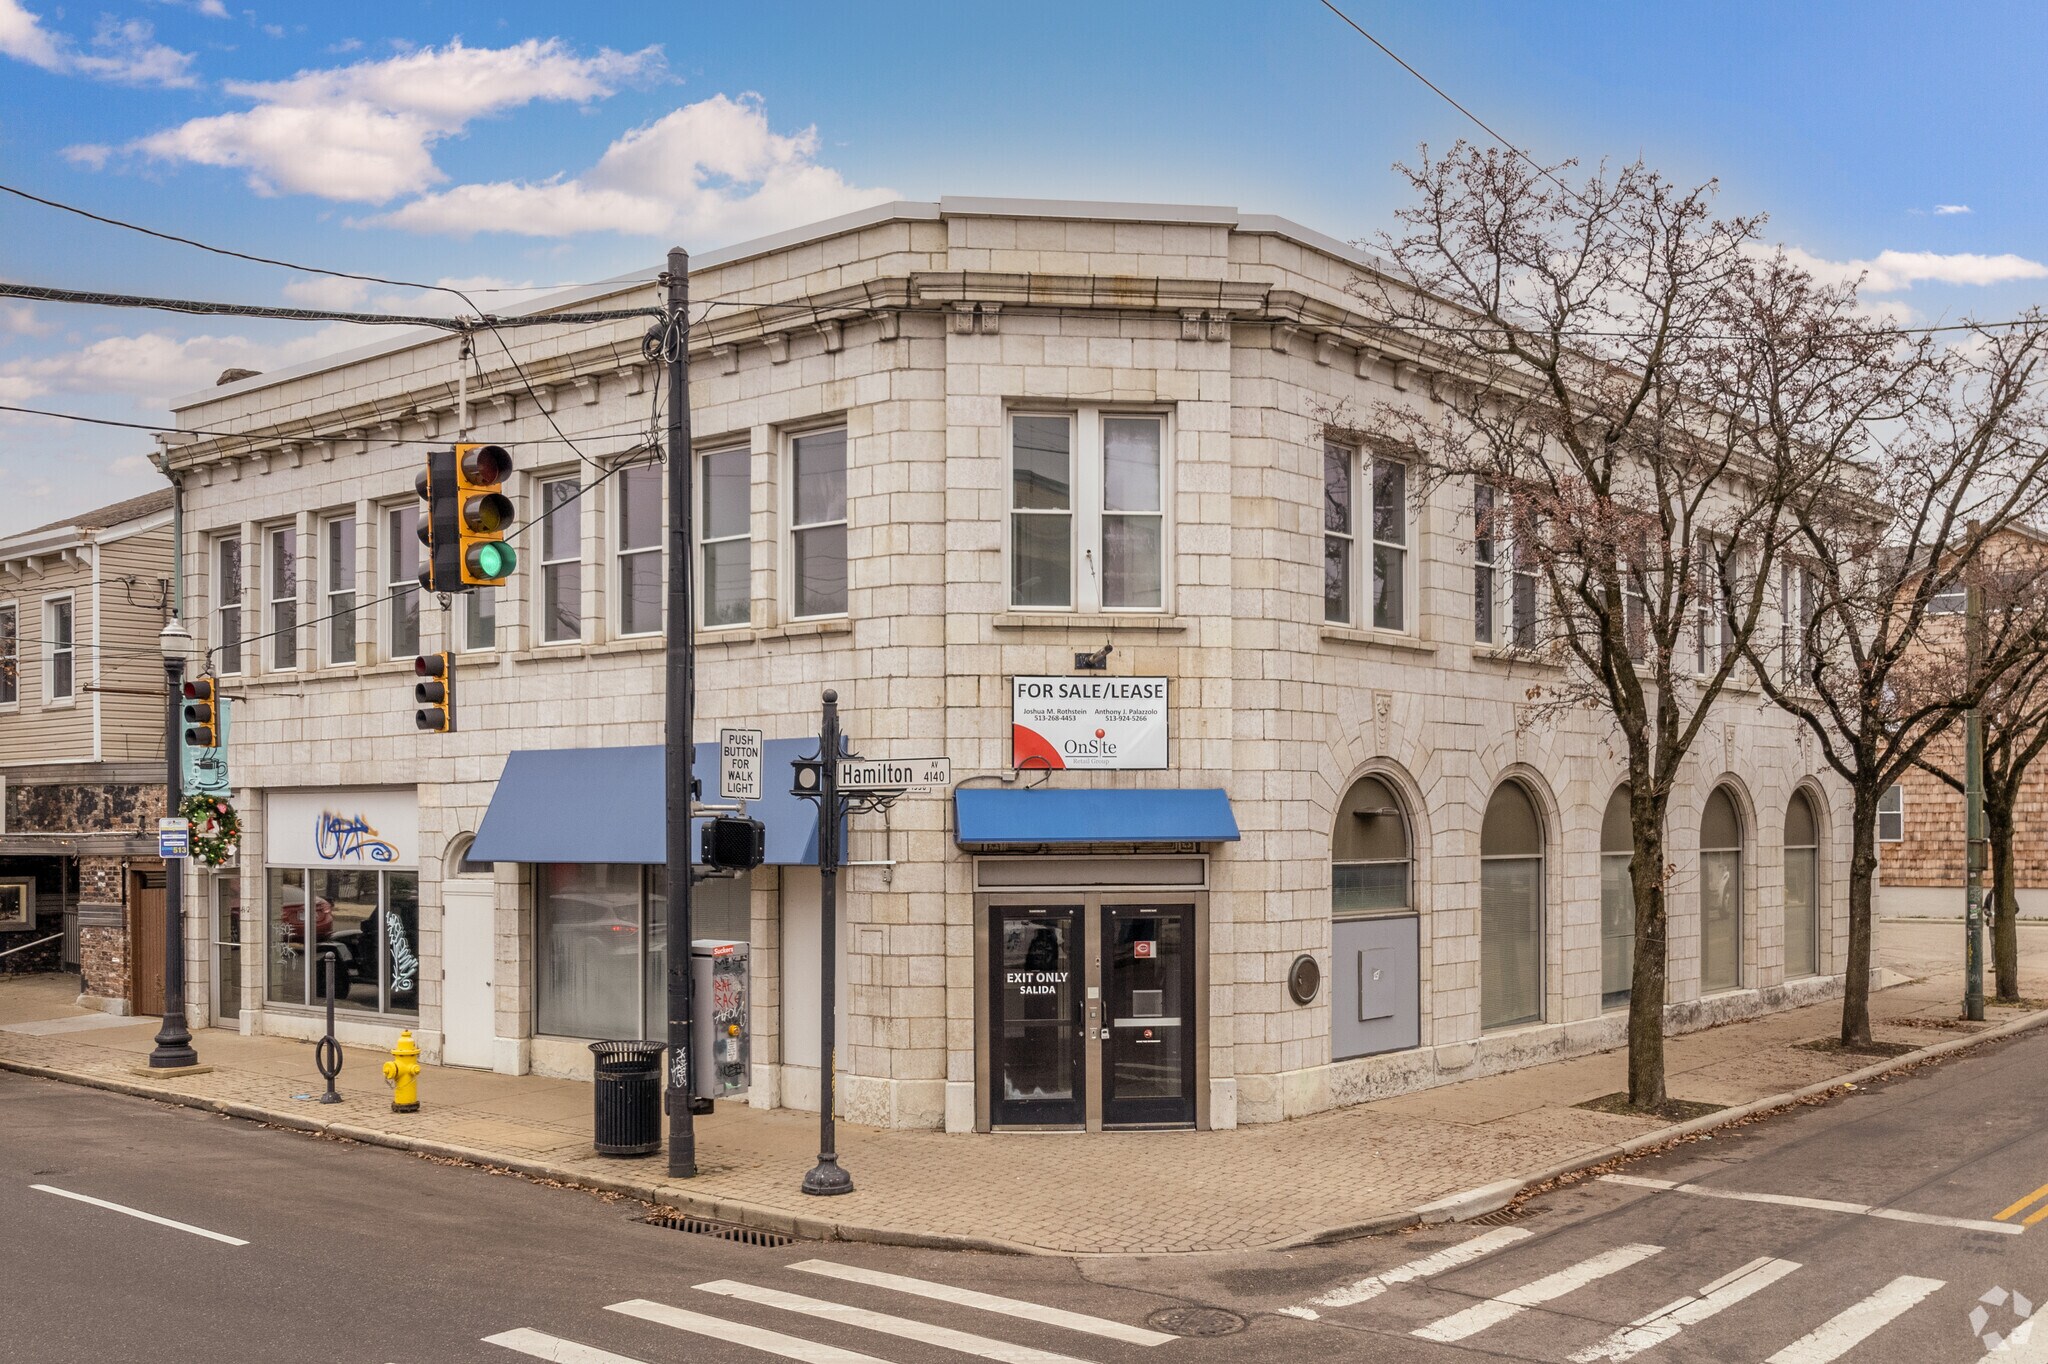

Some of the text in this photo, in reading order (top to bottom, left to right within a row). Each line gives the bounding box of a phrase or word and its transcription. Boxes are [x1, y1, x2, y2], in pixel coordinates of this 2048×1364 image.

[1018, 682, 1164, 699] FOR SALE/LEASE
[729, 735, 754, 745] PUSH
[1064, 732, 1117, 754] OnSite
[724, 746, 758, 757] BUTTON
[732, 759, 750, 769] FOR
[728, 771, 753, 781] WALK
[843, 763, 913, 784] Hamilton
[923, 771, 945, 782] 4140
[727, 782, 753, 793] LIGHT
[1006, 972, 1069, 983] EXIT ONLY
[1019, 985, 1056, 995] SALIDA
